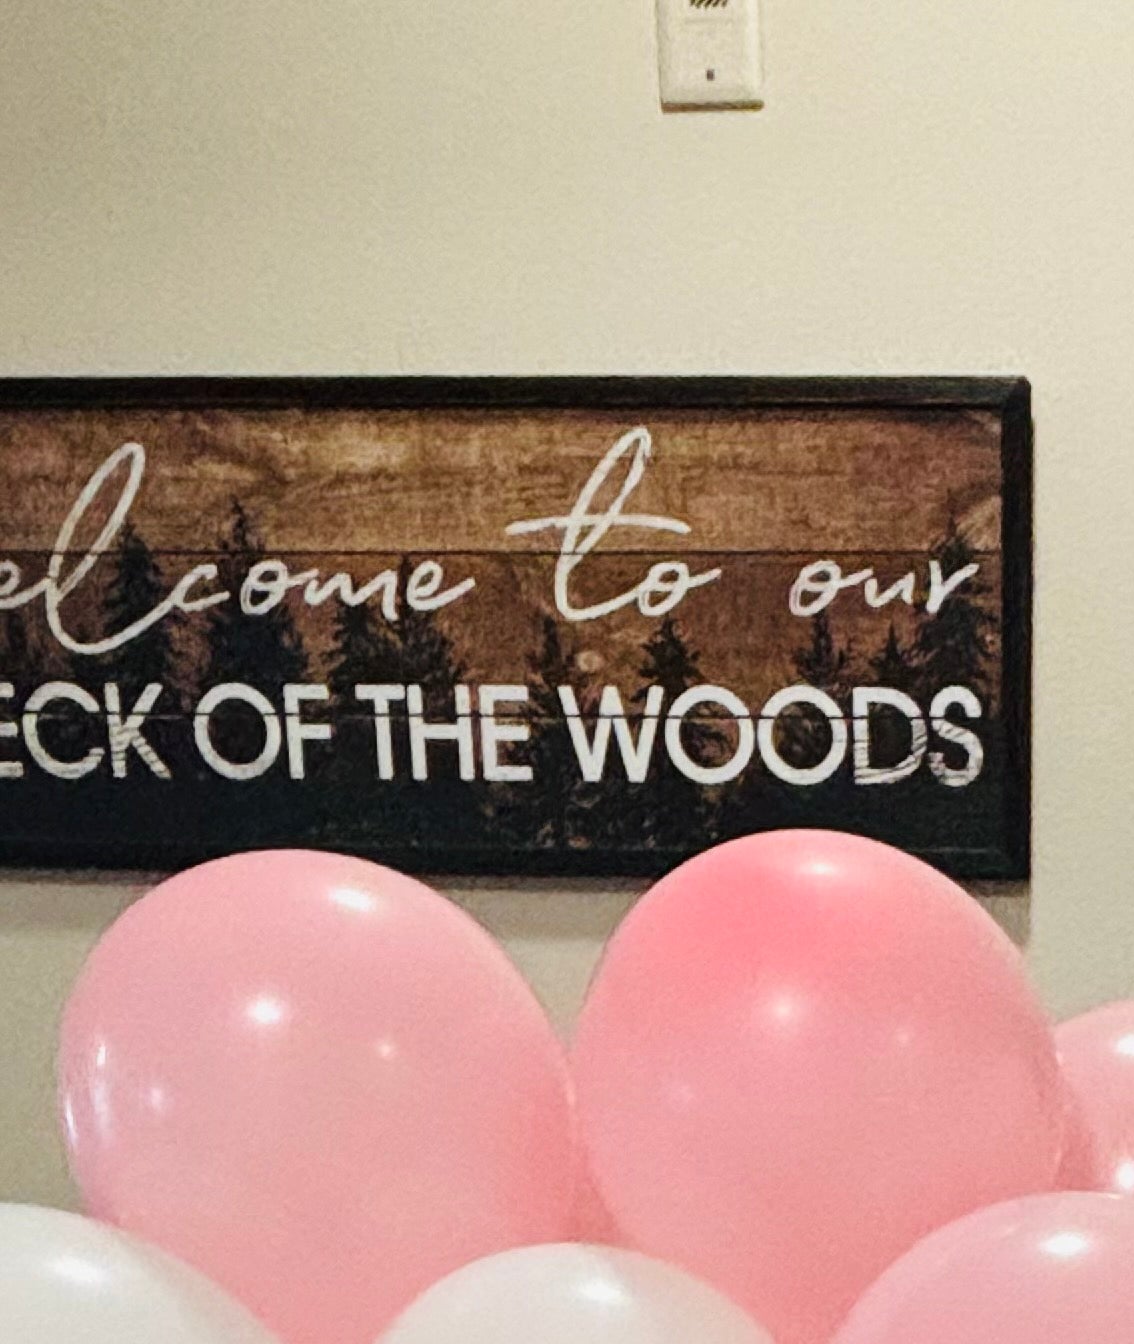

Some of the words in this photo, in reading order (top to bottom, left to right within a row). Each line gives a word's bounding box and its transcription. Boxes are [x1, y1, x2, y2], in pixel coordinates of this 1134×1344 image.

[505, 427, 722, 621] to
[789, 558, 978, 619] our
[195, 682, 331, 782] OF
[356, 682, 533, 782] THE
[559, 683, 983, 787] WOODS
